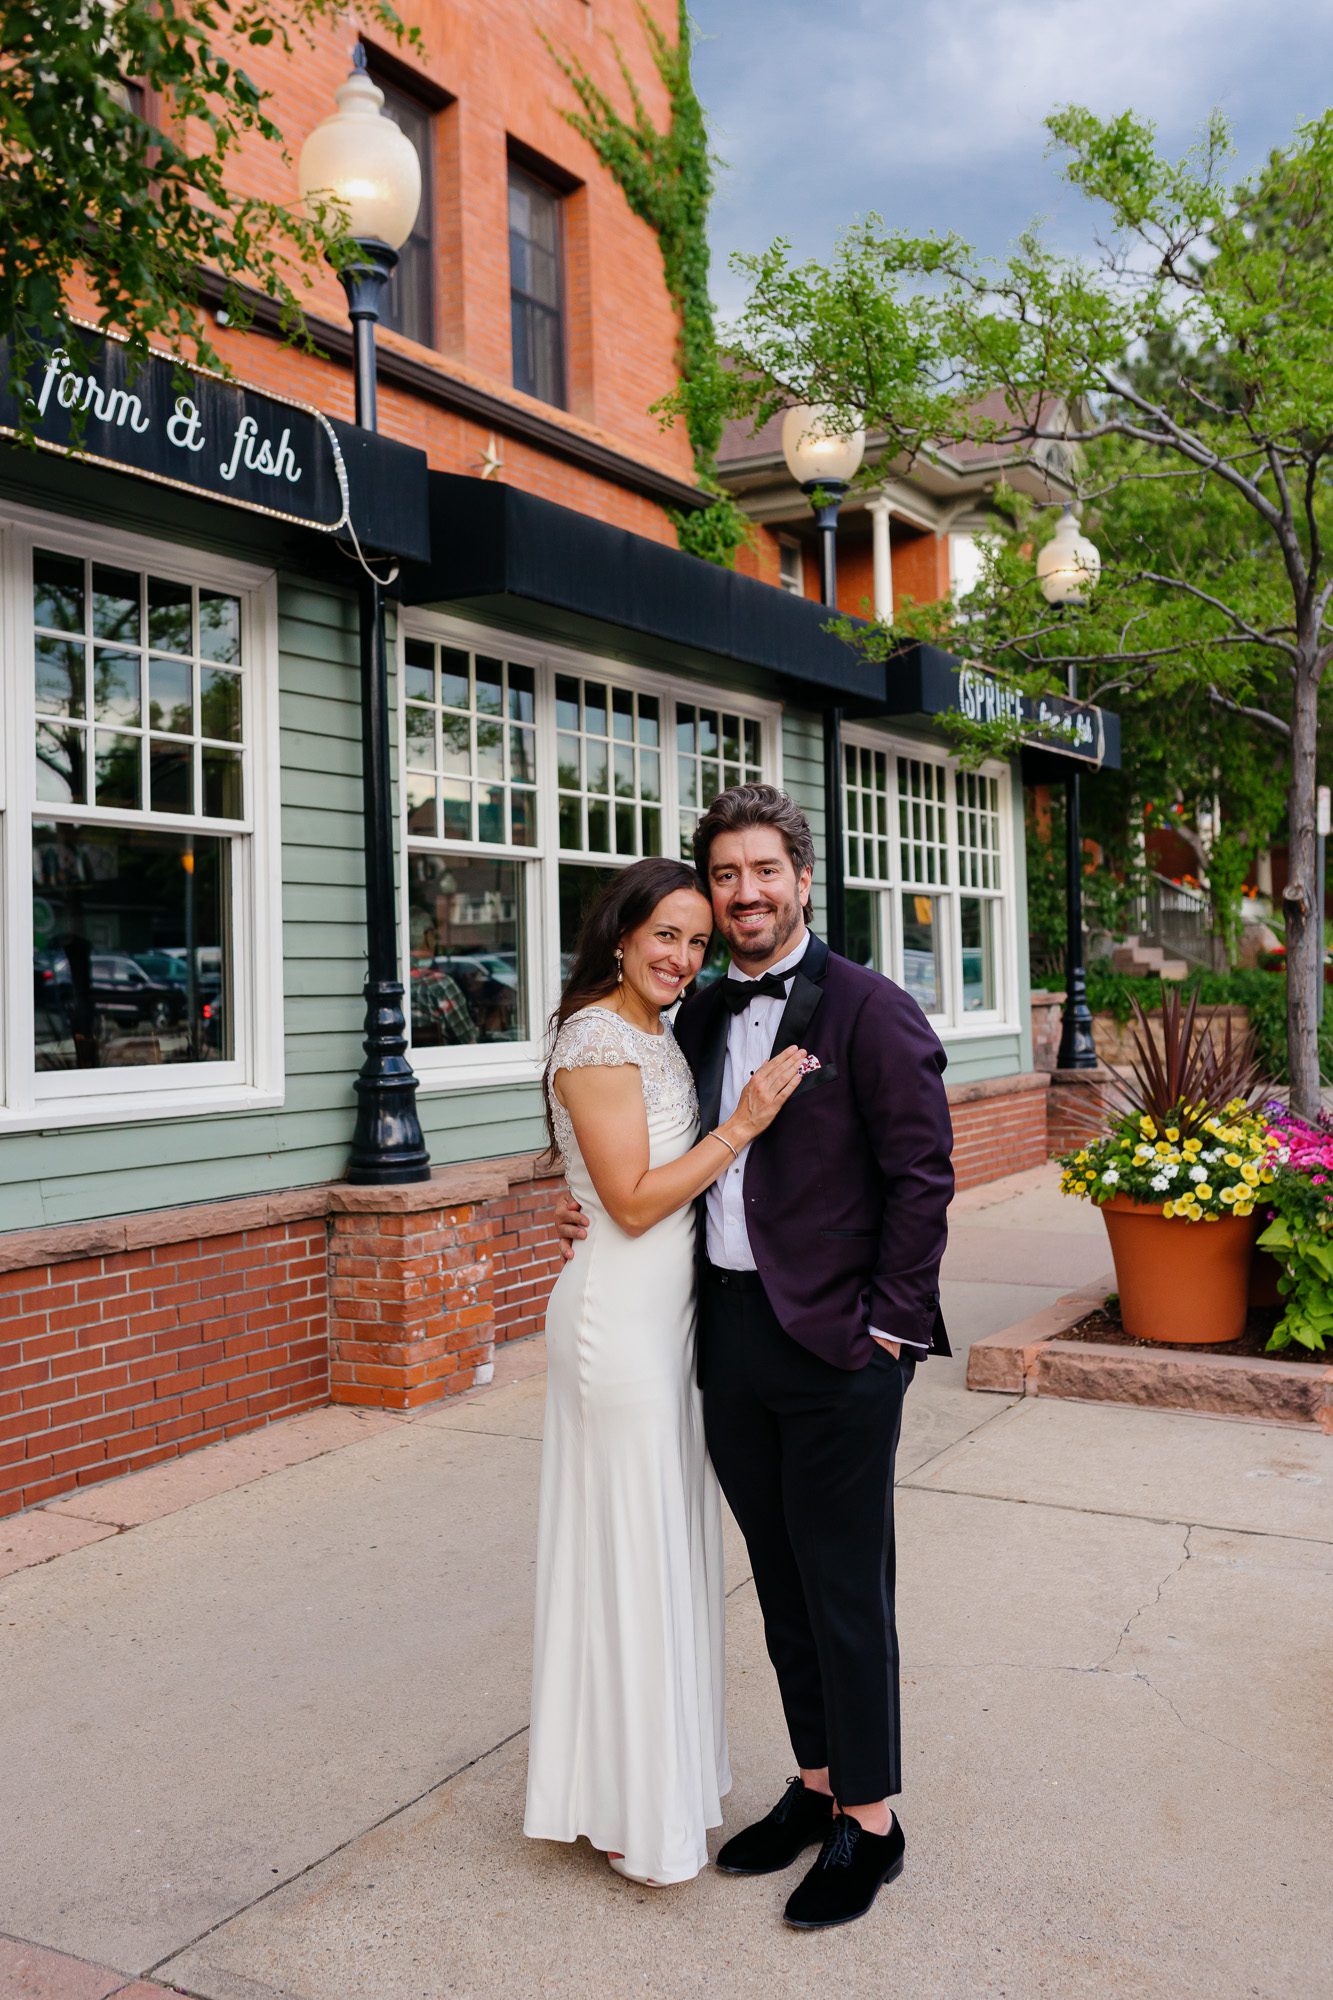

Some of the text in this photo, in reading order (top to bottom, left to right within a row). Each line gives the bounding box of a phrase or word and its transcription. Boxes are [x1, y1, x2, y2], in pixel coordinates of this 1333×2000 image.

[26, 347, 302, 482] farm & fish
